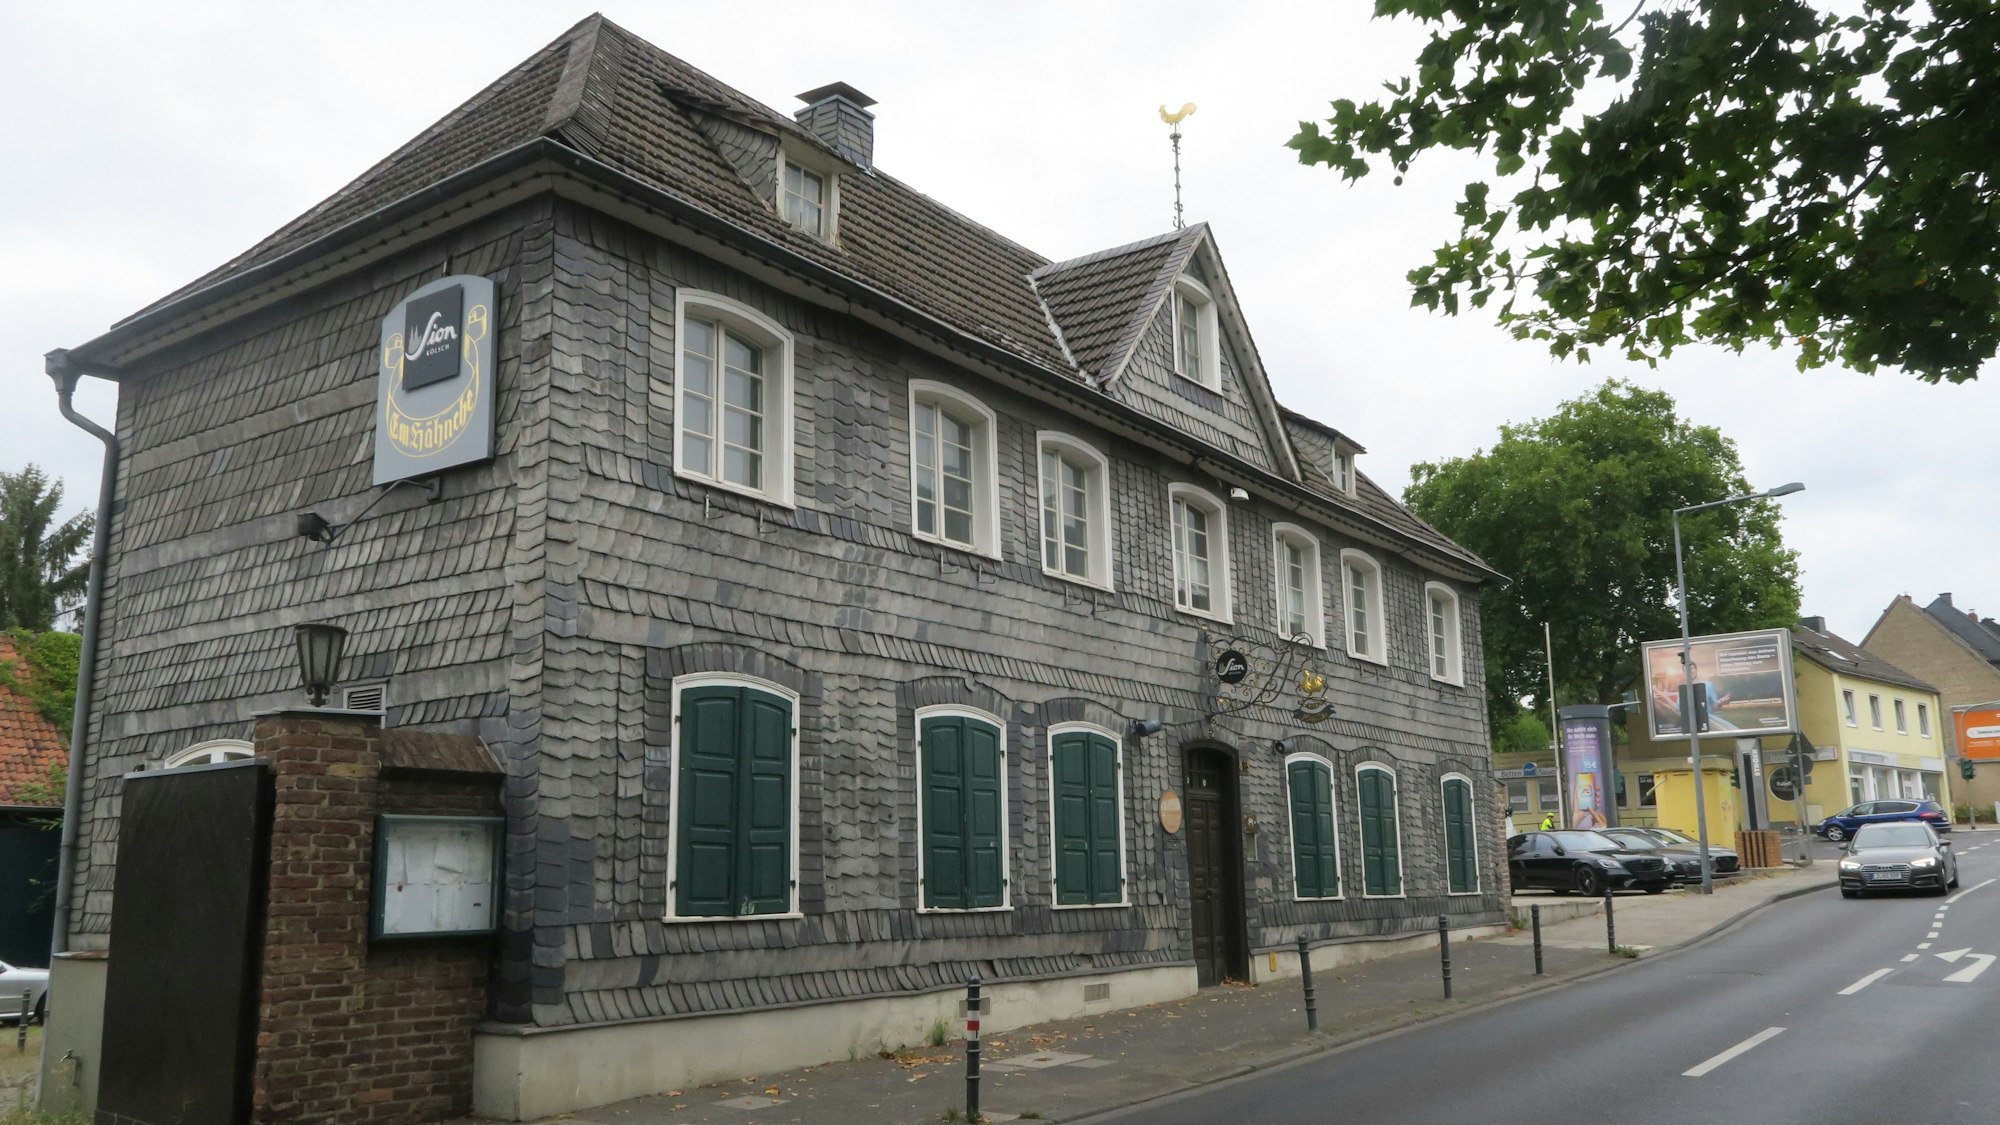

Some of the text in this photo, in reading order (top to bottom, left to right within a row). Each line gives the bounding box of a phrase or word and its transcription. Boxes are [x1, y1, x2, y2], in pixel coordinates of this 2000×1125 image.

[405, 311, 458, 361] Sion
[426, 343, 450, 356] KÖLSCH
[1217, 658, 1245, 675] Sion
[1501, 770, 1522, 778] Betten
